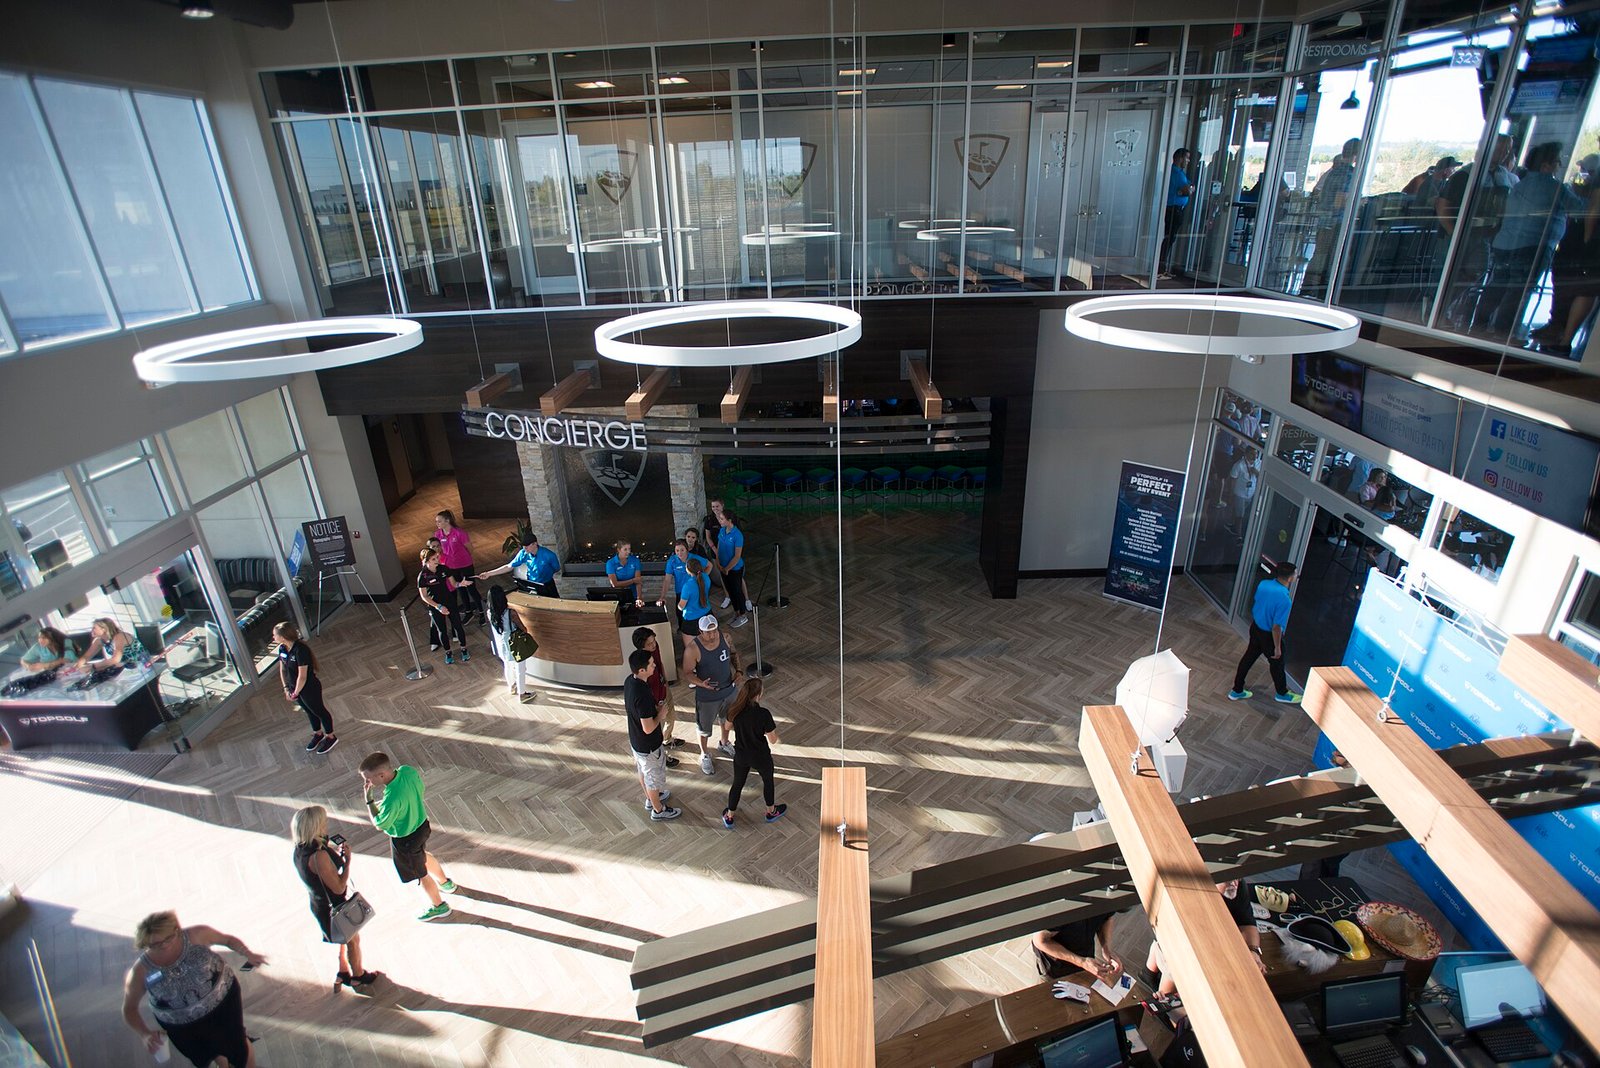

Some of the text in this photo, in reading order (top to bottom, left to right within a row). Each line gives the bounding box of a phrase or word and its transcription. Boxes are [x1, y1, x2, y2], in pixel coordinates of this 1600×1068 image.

[1303, 44, 1367, 57] RESTROOMS
[1310, 378, 1353, 401] TOPGOLF
[485, 411, 647, 451] CONCIERGE
[1510, 424, 1526, 441] LIKE
[1528, 431, 1539, 445] US
[1505, 451, 1536, 473] FOLLOW
[1537, 463, 1549, 478] US
[1130, 476, 1174, 492] PERFECT
[1137, 486, 1151, 494] ANY
[1151, 489, 1171, 498] EVENT
[1502, 476, 1532, 498] FOLLOW
[1532, 489, 1544, 504] US
[309, 520, 342, 537] NOTICE
[30, 715, 89, 724] TOPGOLF
[1415, 714, 1442, 741] TOPGOLF
